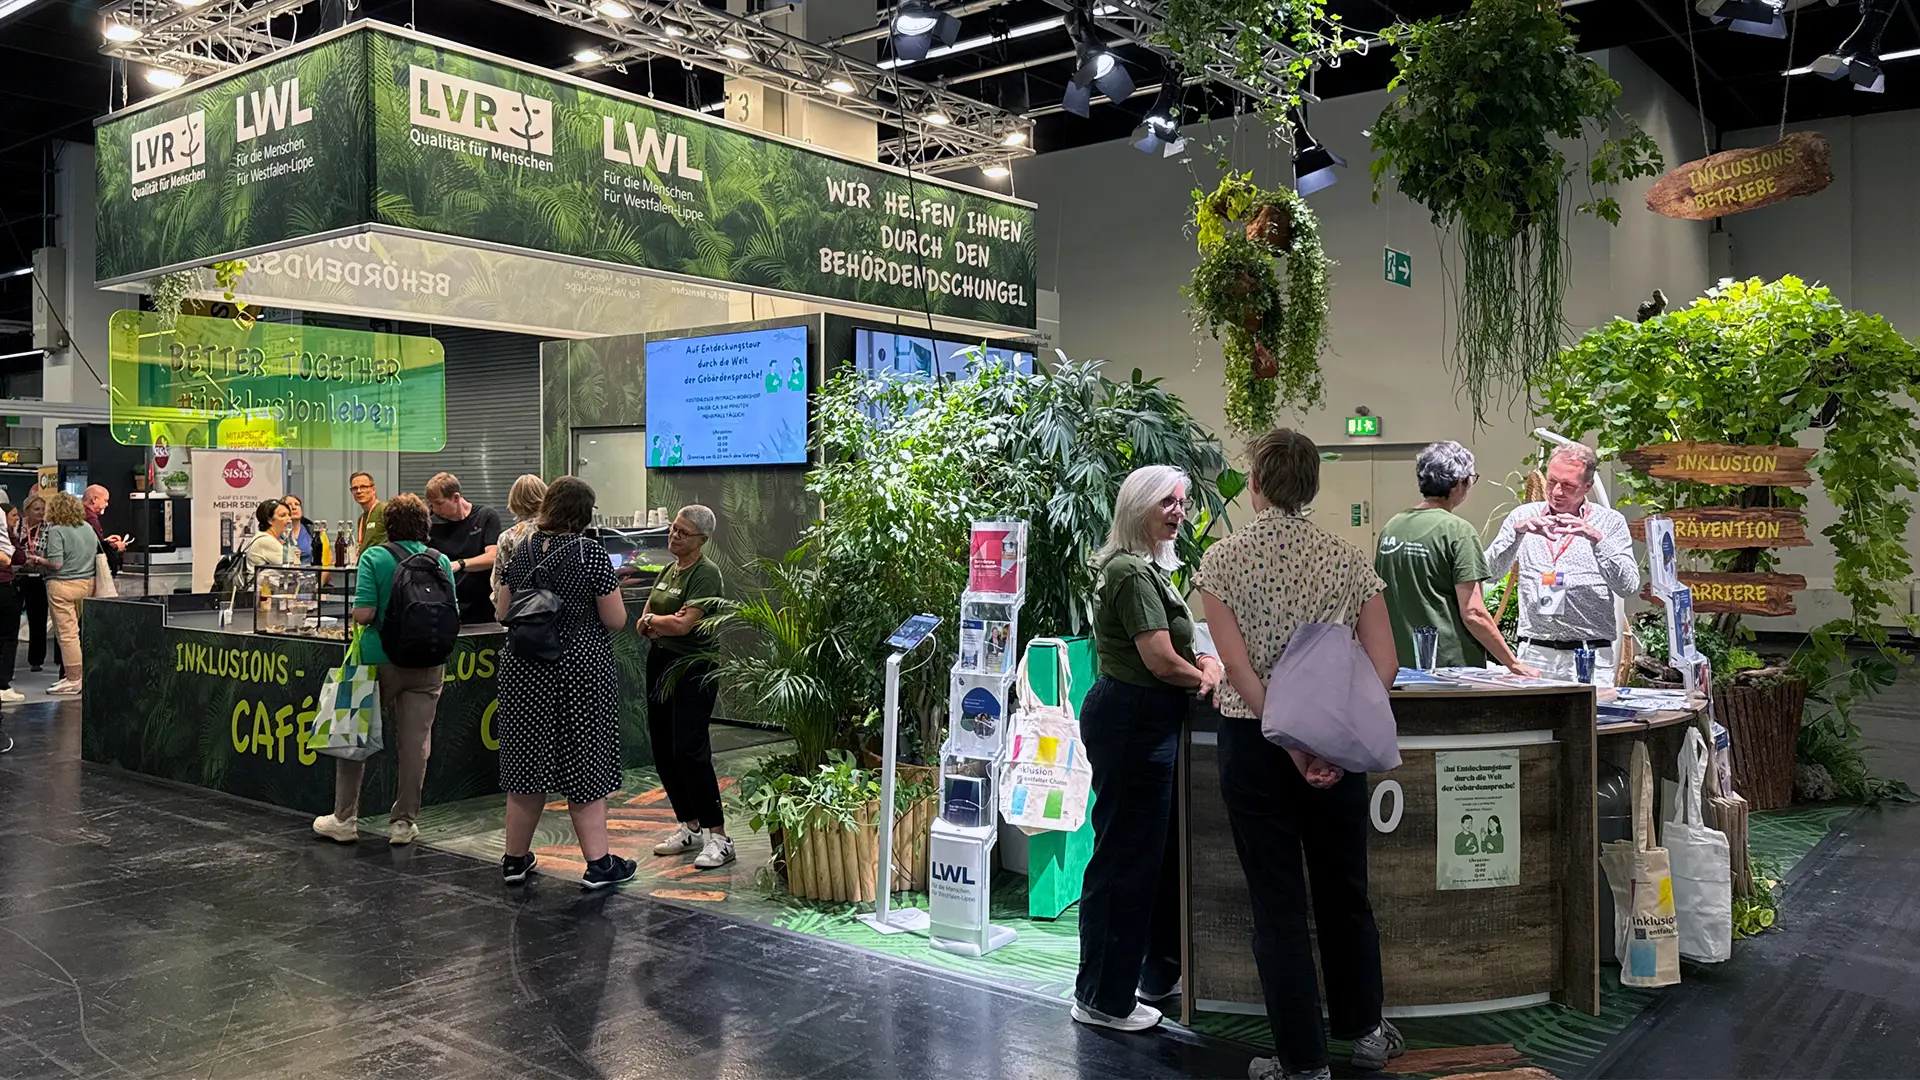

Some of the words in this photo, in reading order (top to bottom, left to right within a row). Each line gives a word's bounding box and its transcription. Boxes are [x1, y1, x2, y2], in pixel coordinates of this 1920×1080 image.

[237, 77, 313, 143] LWL
[419, 78, 499, 133] LVR
[136, 131, 175, 173] LVR
[236, 153, 250, 167] Für
[250, 148, 263, 163] die
[263, 137, 306, 159] Menschen.
[409, 128, 466, 153] Qualität
[469, 141, 488, 158] für
[491, 146, 554, 172] Menschen
[603, 115, 703, 182] LWL
[132, 179, 159, 201] Qualität
[159, 177, 170, 193] für
[170, 168, 206, 189] Menschen
[236, 173, 250, 186] Für
[250, 156, 315, 183] Westfalen-Lippe.
[1688, 147, 1804, 190] INKLUSIONS-
[603, 170, 621, 185] Für
[623, 175, 640, 190] die
[643, 179, 695, 202] Menschen.
[1693, 176, 1777, 211] BETRIEBE
[604, 188, 621, 204] Für
[623, 193, 706, 222] Westfalen-Lippe.
[826, 176, 871, 209] WIR
[967, 211, 1022, 243] IHNEN
[880, 225, 942, 259] DURCH
[955, 241, 990, 268] DEN
[819, 248, 1028, 307] BEHÖRDENDSCHUNGEL
[169, 342, 267, 378] BETTER
[686, 345, 699, 354] Auf
[701, 341, 762, 353] Entdeckungstour
[697, 359, 718, 369] durch
[719, 358, 730, 367] die
[732, 356, 749, 366] Welt
[283, 350, 403, 387] TOGETHER
[684, 375, 696, 385] der
[697, 370, 763, 384] Gebärdensprache!
[176, 386, 398, 426] #inklusionleben
[222, 467, 254, 479] SiSiSi
[1675, 455, 1778, 473] INKLUSION
[213, 501, 239, 509] MEHR
[1674, 517, 1781, 539] RÄVENTION
[1689, 582, 1768, 602] ARRIERE
[231, 695, 319, 766] CAFÉ
[1018, 765, 1053, 776] nklusion
[1456, 764, 1512, 773] Entdeckungstour
[1475, 773, 1487, 781] die
[932, 861, 976, 885] LWL
